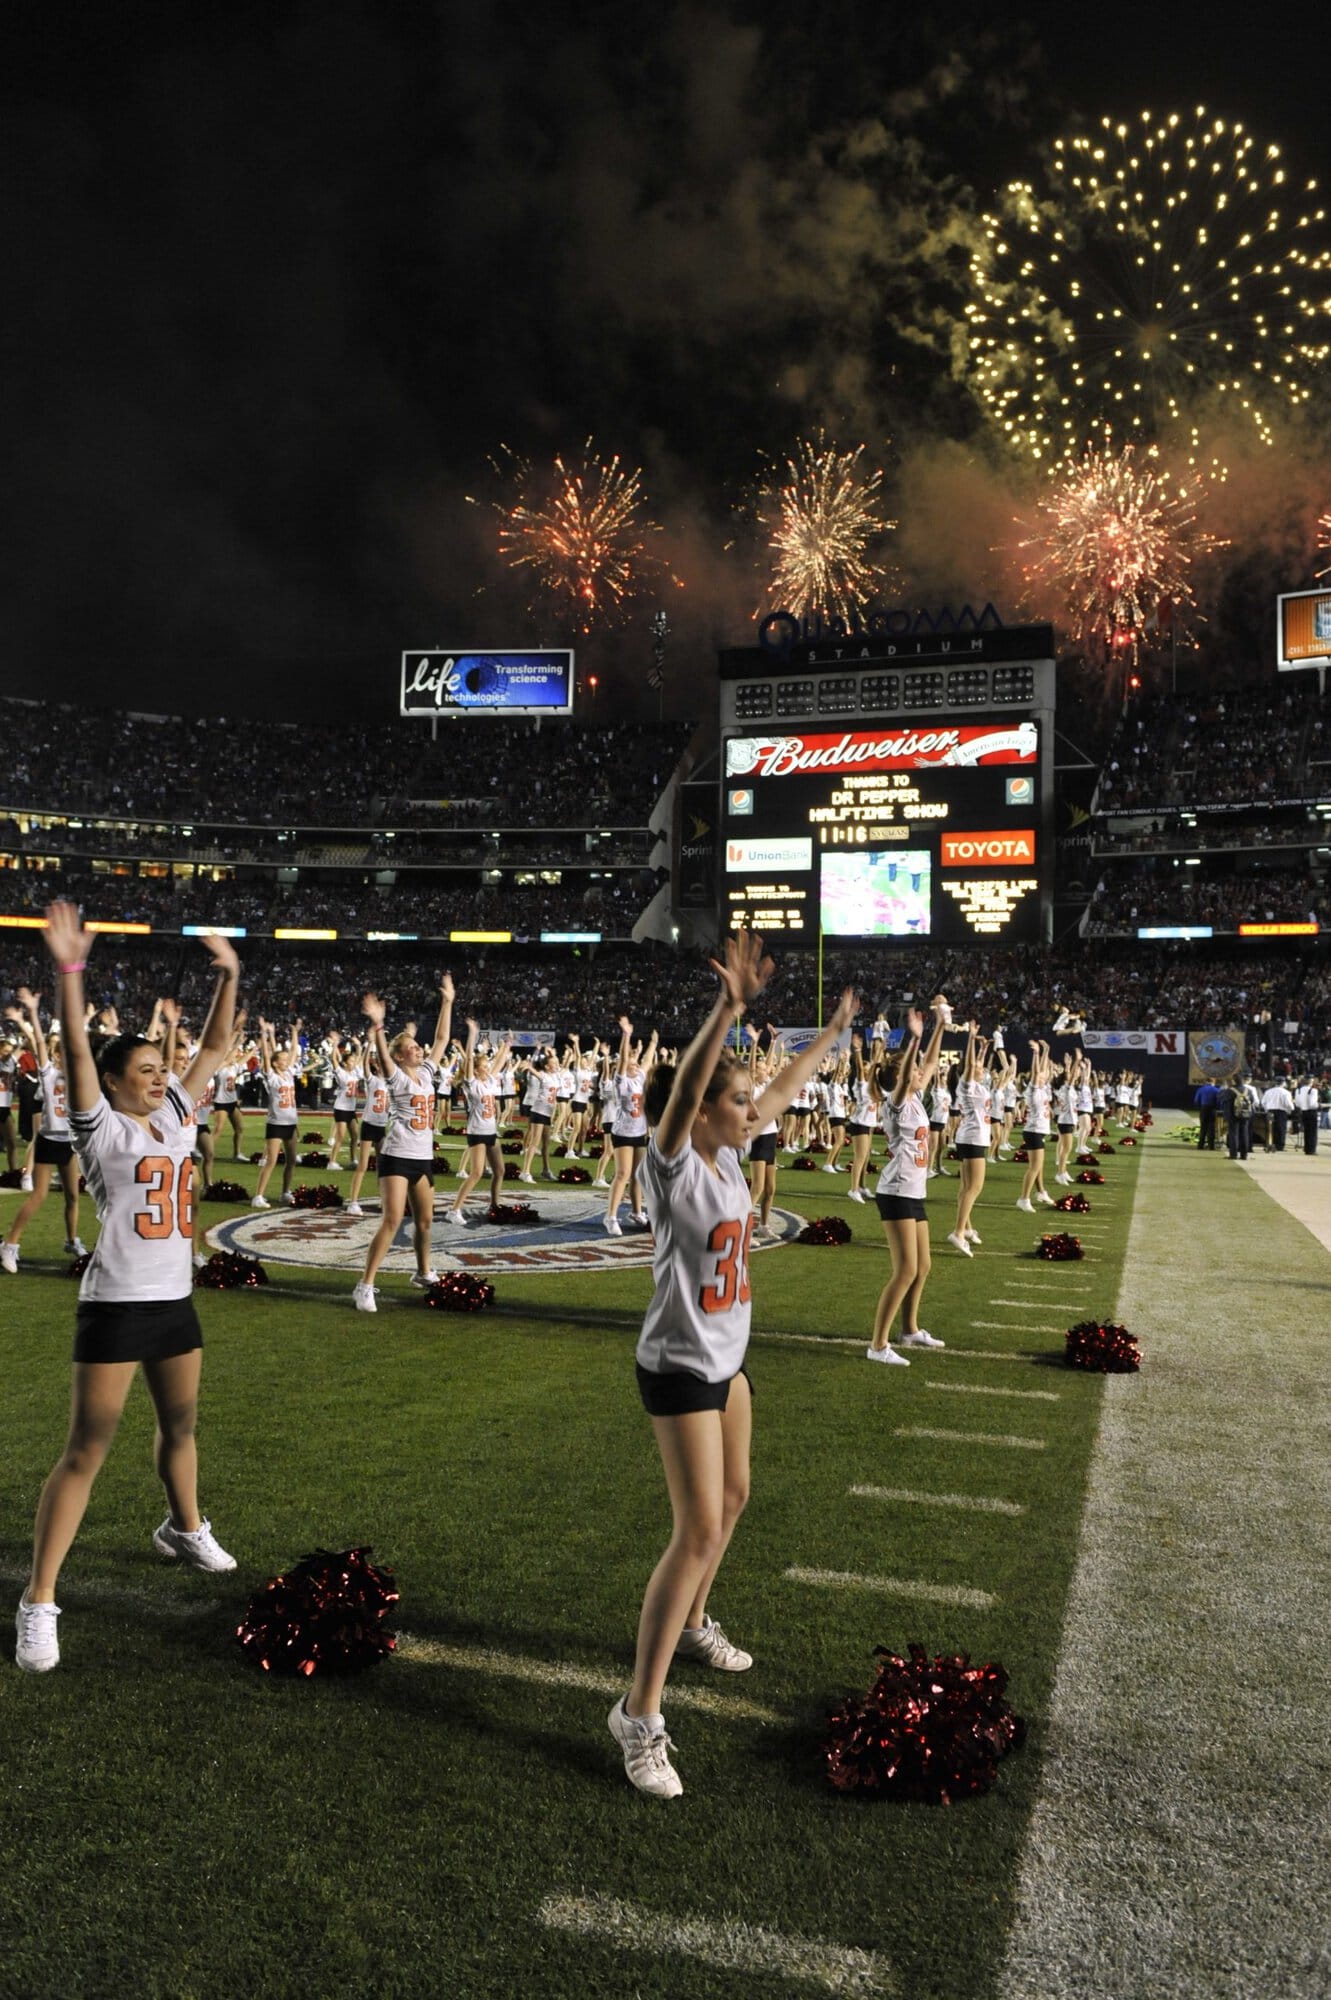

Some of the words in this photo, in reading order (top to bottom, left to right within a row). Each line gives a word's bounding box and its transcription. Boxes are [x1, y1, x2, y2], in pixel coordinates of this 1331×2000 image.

[758, 602, 1004, 661] QUALCOMM
[809, 639, 983, 661] STADIUM
[495, 664, 564, 676] Transforming
[509, 674, 548, 683] science
[406, 658, 461, 705] life
[752, 729, 959, 776] Budweiser
[842, 776, 888, 788] THANKS
[892, 774, 910, 787] TO
[831, 791, 854, 805] DR
[860, 788, 920, 804] PEPPER
[809, 806, 894, 822] HALFTIME
[903, 803, 948, 819] SHOW
[821, 826, 868, 844] 11:16
[748, 850, 808, 861] UnionBank
[945, 840, 1031, 859] TOYOTA
[1154, 1033, 1177, 1053] N
[939, 1050, 960, 1067] 25
